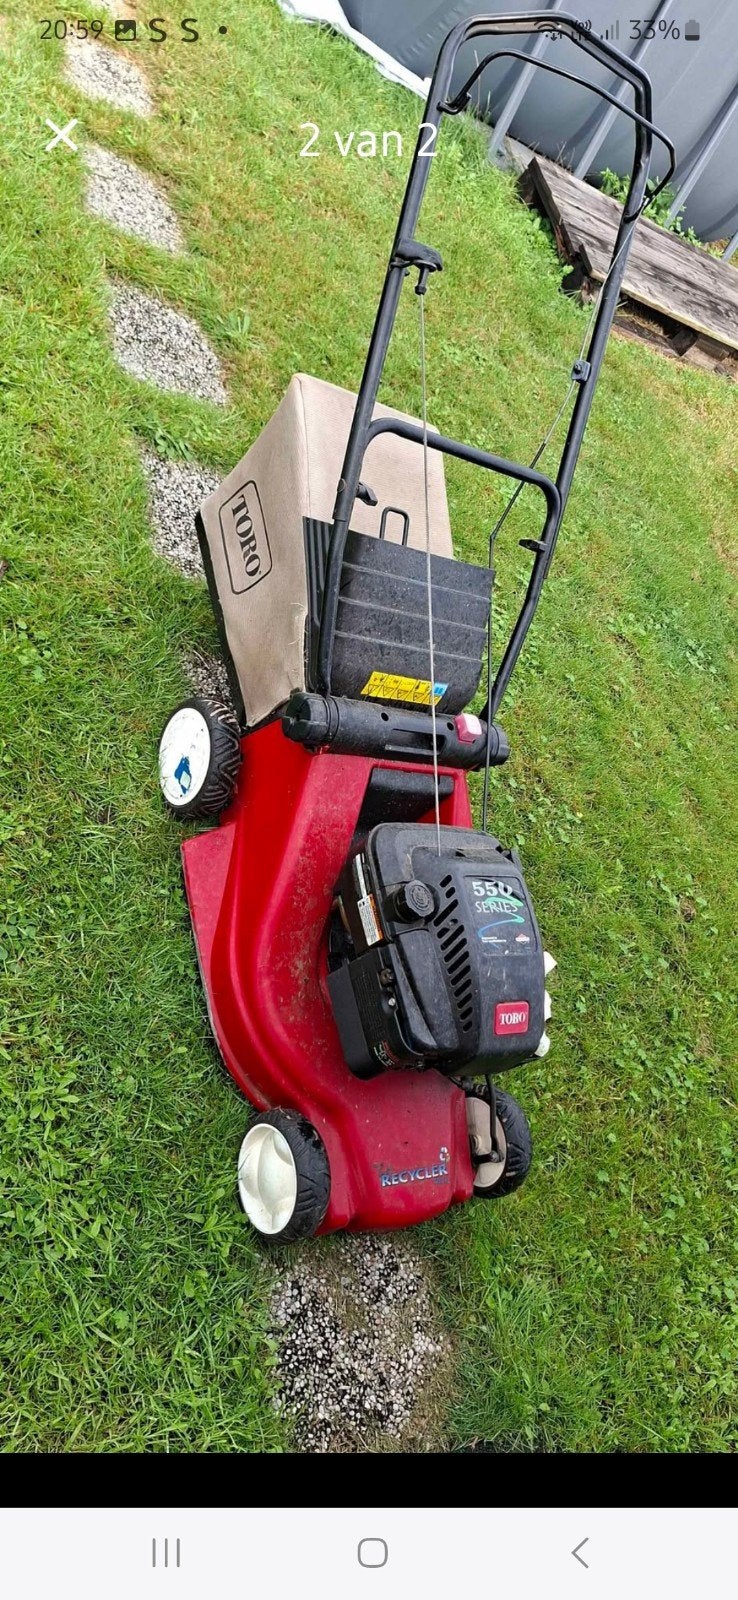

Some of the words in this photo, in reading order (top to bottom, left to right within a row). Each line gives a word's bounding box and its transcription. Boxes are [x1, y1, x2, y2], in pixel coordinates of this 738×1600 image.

[231, 493, 262, 577] TORO
[471, 880, 514, 898] 550
[474, 900, 519, 913] SERIES
[499, 1011, 527, 1025] TORO
[380, 1163, 449, 1188] RECYCLER
